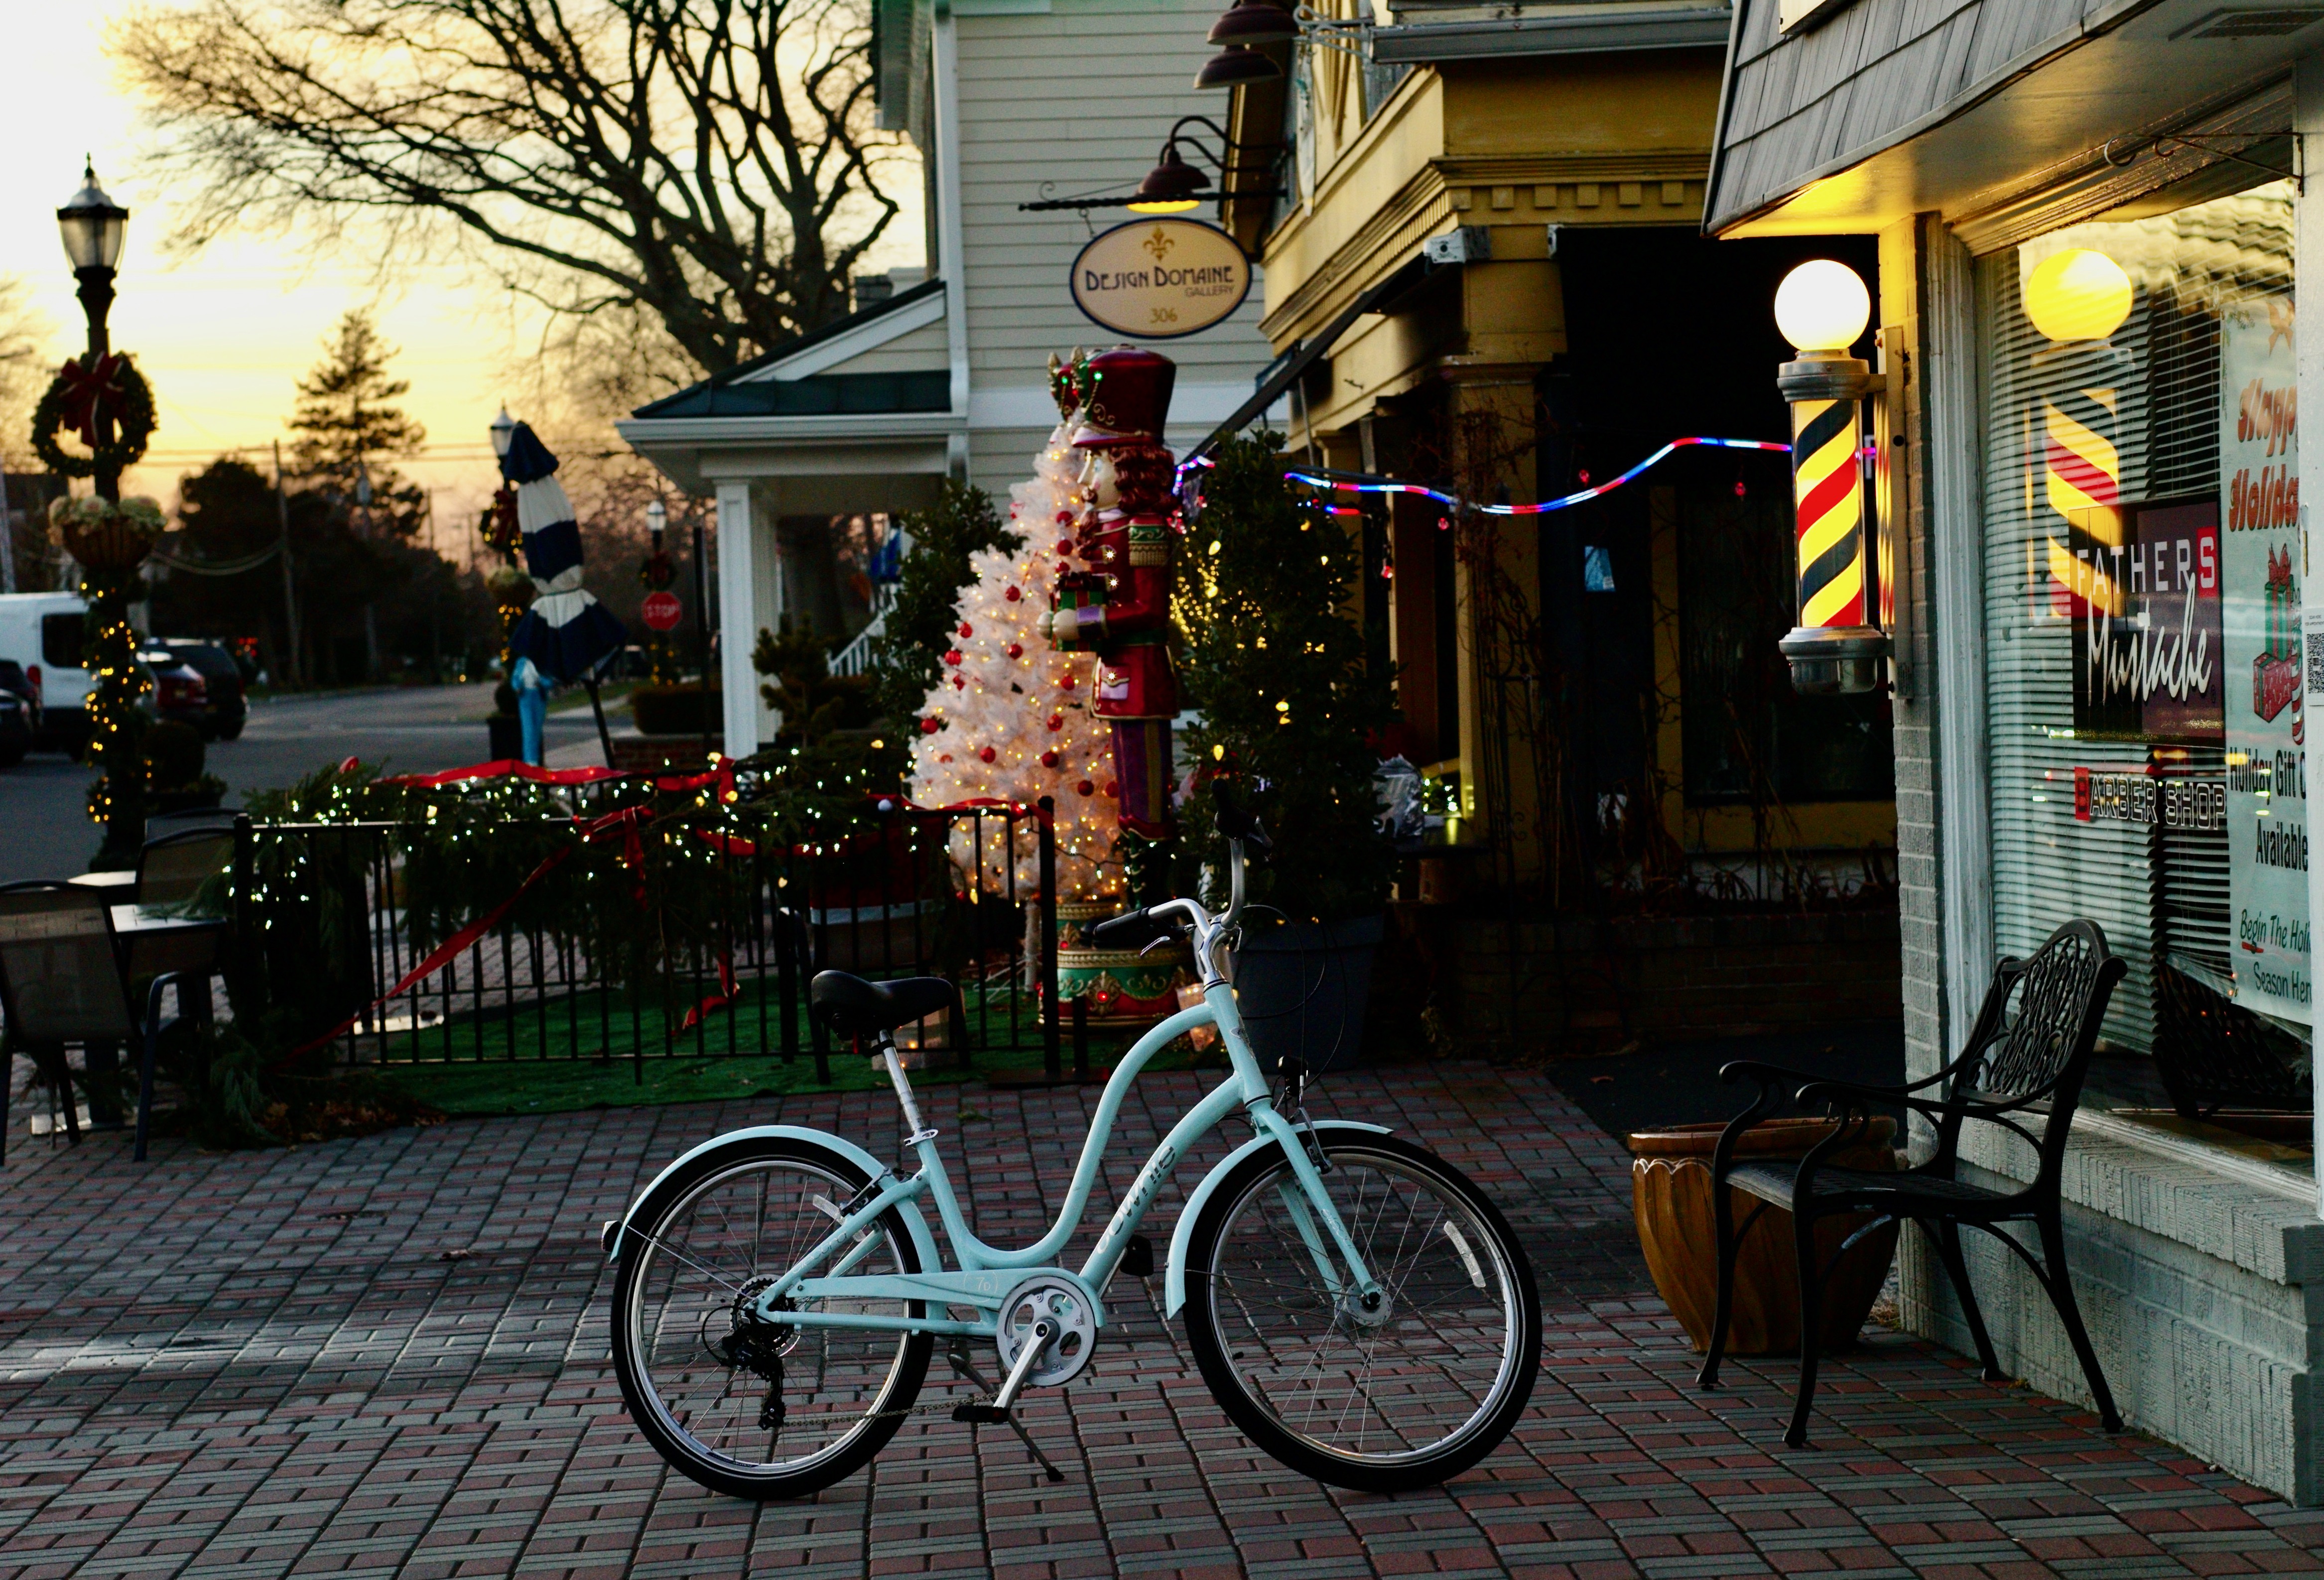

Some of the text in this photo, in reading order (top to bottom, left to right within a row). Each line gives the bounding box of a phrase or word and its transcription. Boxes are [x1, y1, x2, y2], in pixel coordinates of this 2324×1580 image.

[1086, 265, 1234, 290] DESIGN DOMAINE
[1185, 285, 1234, 297] GALLERY
[1150, 308, 1178, 323] 306
[2238, 377, 2298, 457] Happ
[2229, 464, 2300, 544] Holida
[2076, 536, 2215, 597] FATHERS
[647, 604, 678, 618] STOP
[2087, 572, 2212, 707] Mustache
[2077, 774, 2226, 830] BARBER SHOP
[2230, 747, 2272, 805] Holiday
[2276, 749, 2296, 797] Gift
[2256, 819, 2308, 871] Available
[2240, 909, 2311, 954] Begin The Holi
[2254, 962, 2312, 1004] Season Her
